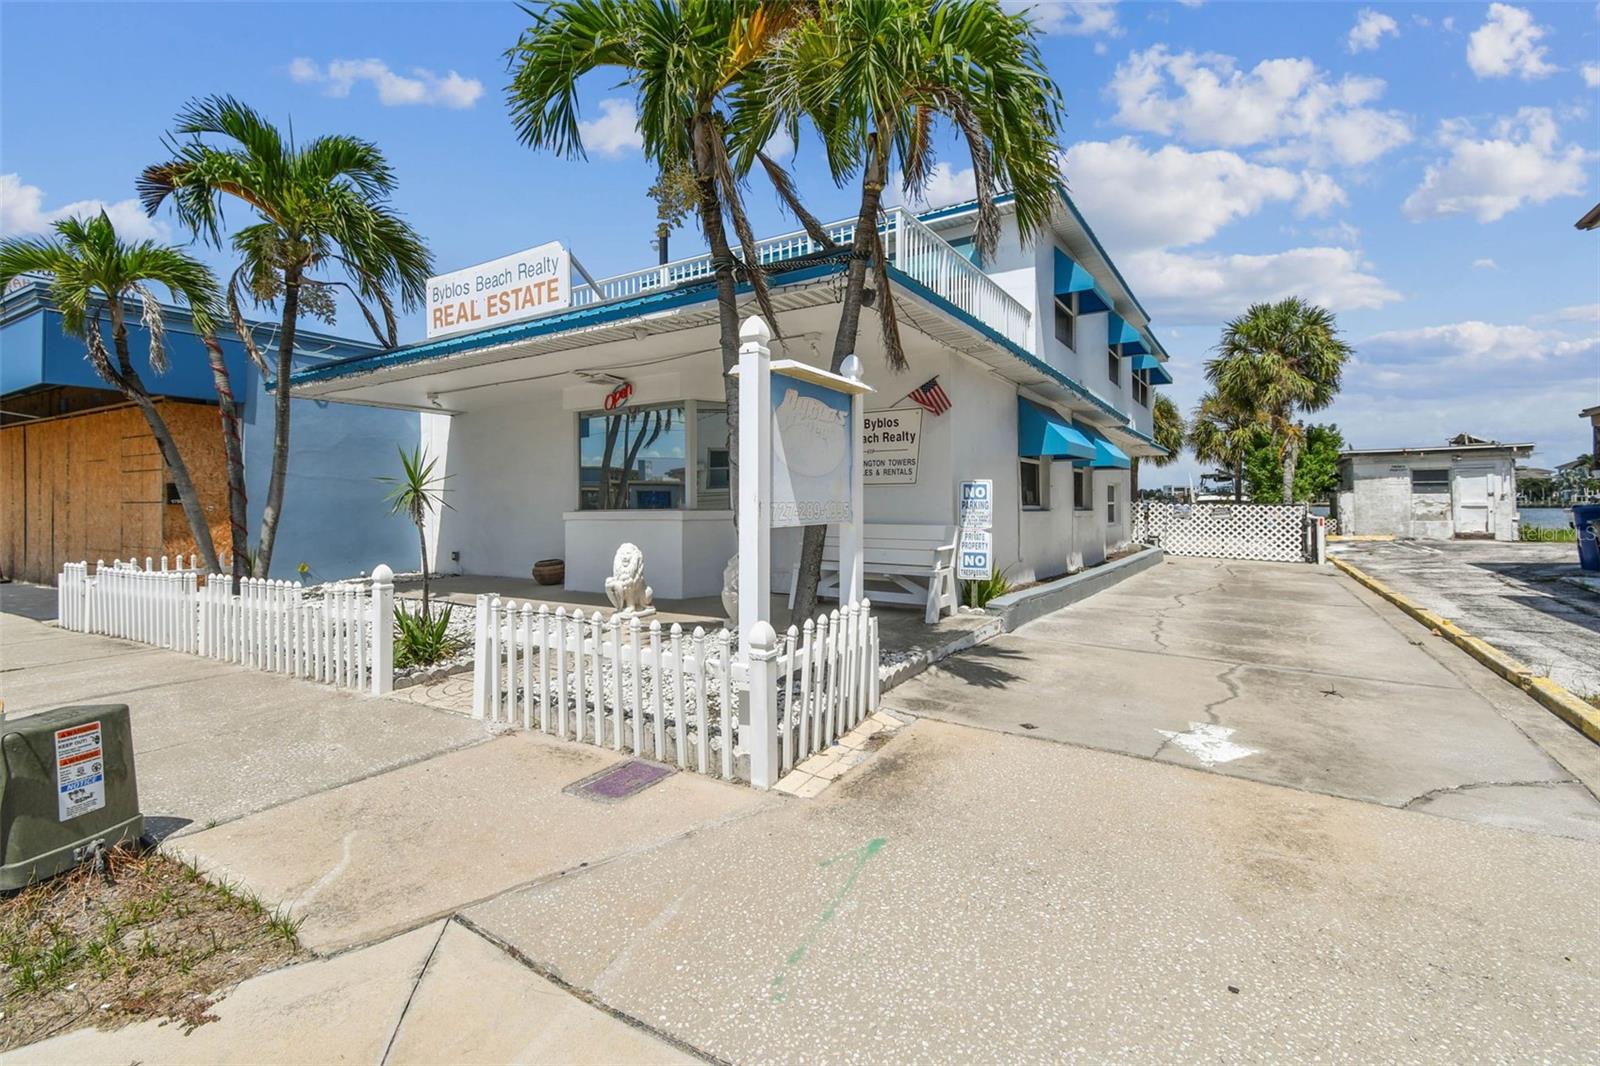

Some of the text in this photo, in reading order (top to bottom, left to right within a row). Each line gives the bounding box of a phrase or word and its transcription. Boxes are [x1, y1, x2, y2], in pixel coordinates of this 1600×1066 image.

[432, 256, 559, 304] Byblos Beach Realty
[433, 278, 560, 329] REAL ESTATE
[605, 383, 632, 411] Open
[864, 418, 899, 431] Byblos
[863, 431, 916, 444] ach Realty
[863, 458, 916, 467] NGTON TOWERS
[876, 468, 880, 476] &
[883, 468, 913, 476] RENTALS
[964, 486, 986, 499] NO
[961, 500, 989, 510] PARKING
[964, 532, 985, 541] PRIVATE
[962, 541, 988, 550] PROPERTY
[964, 554, 986, 567] NO
[67, 776, 96, 790] NOTICE
